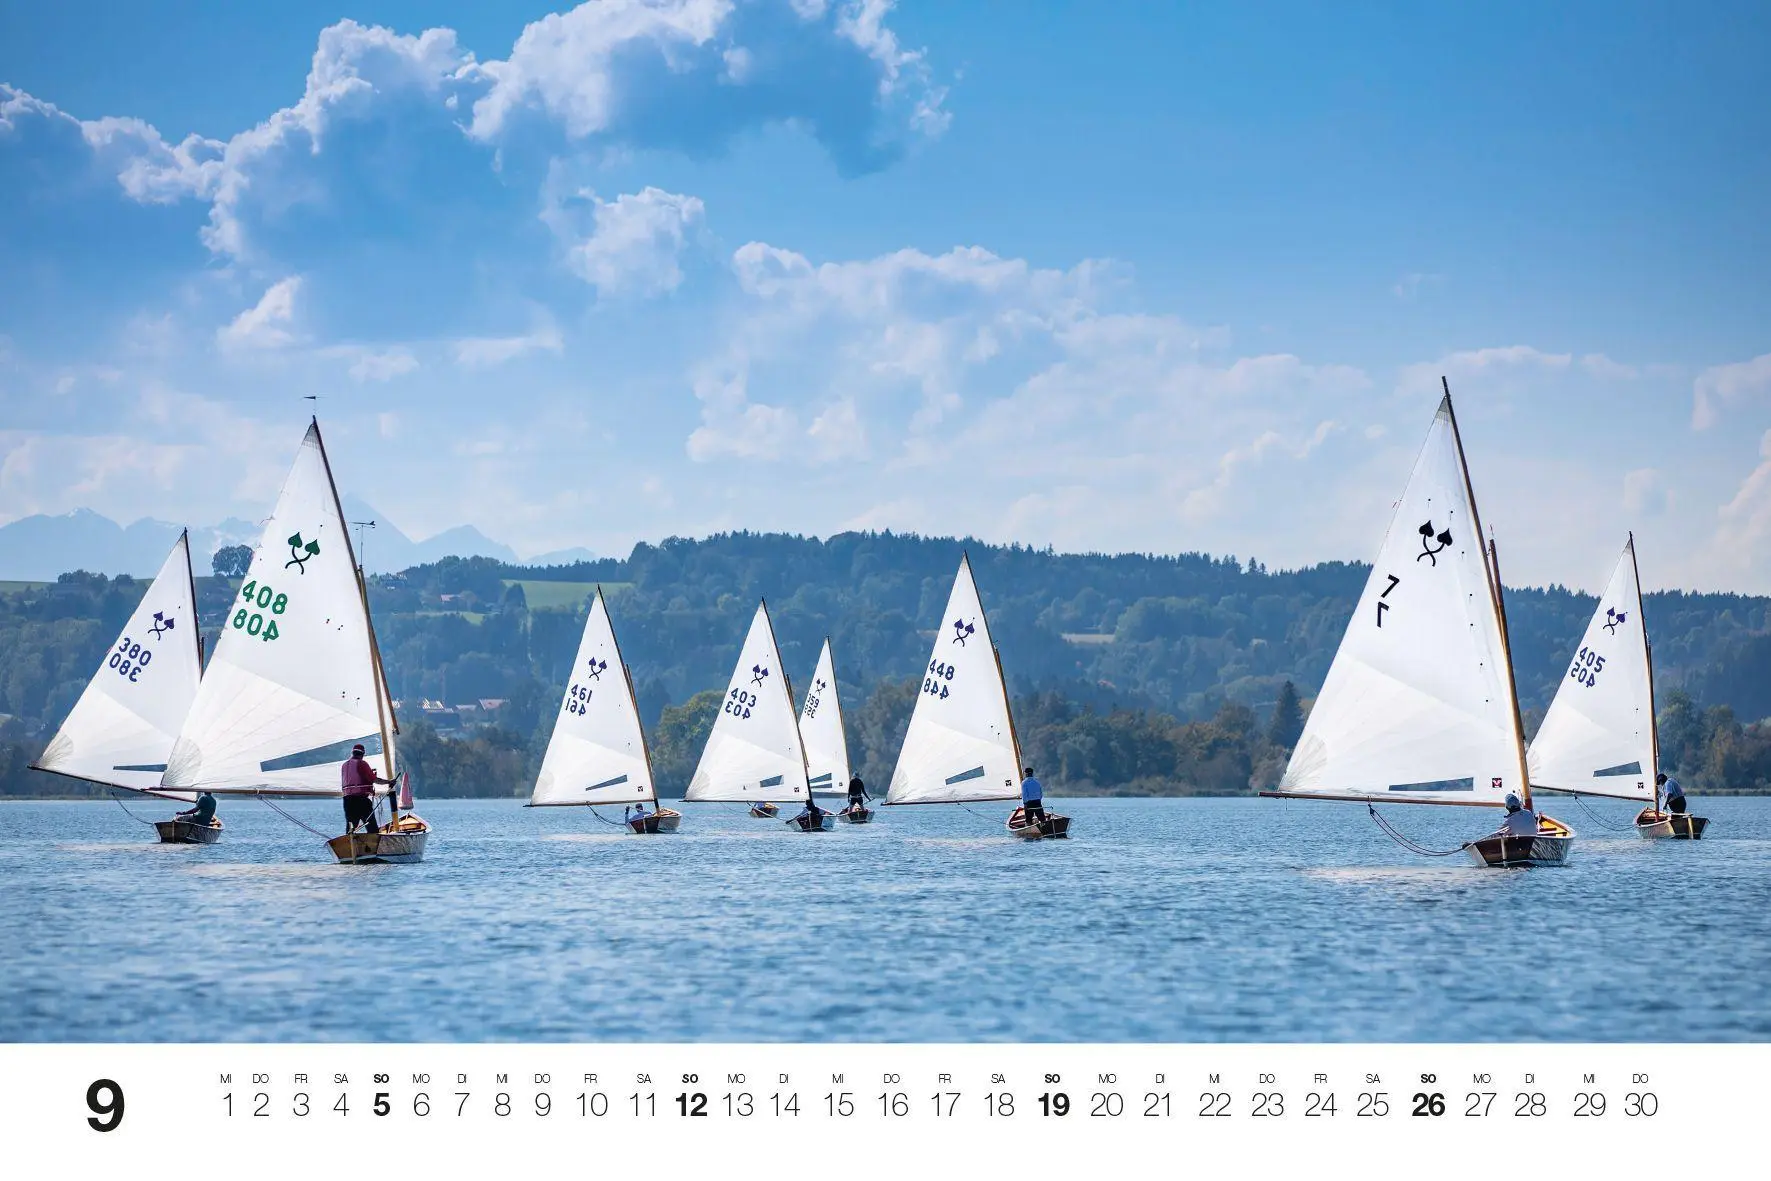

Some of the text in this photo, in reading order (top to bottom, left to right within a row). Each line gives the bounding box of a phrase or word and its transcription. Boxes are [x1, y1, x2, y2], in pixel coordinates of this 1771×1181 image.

[242, 580, 288, 615] 408
[1381, 574, 1400, 598] 7
[118, 637, 152, 666] 380
[1580, 647, 1606, 673] 405
[930, 659, 955, 681] 448
[571, 684, 592, 703] 461
[730, 688, 757, 708] 403
